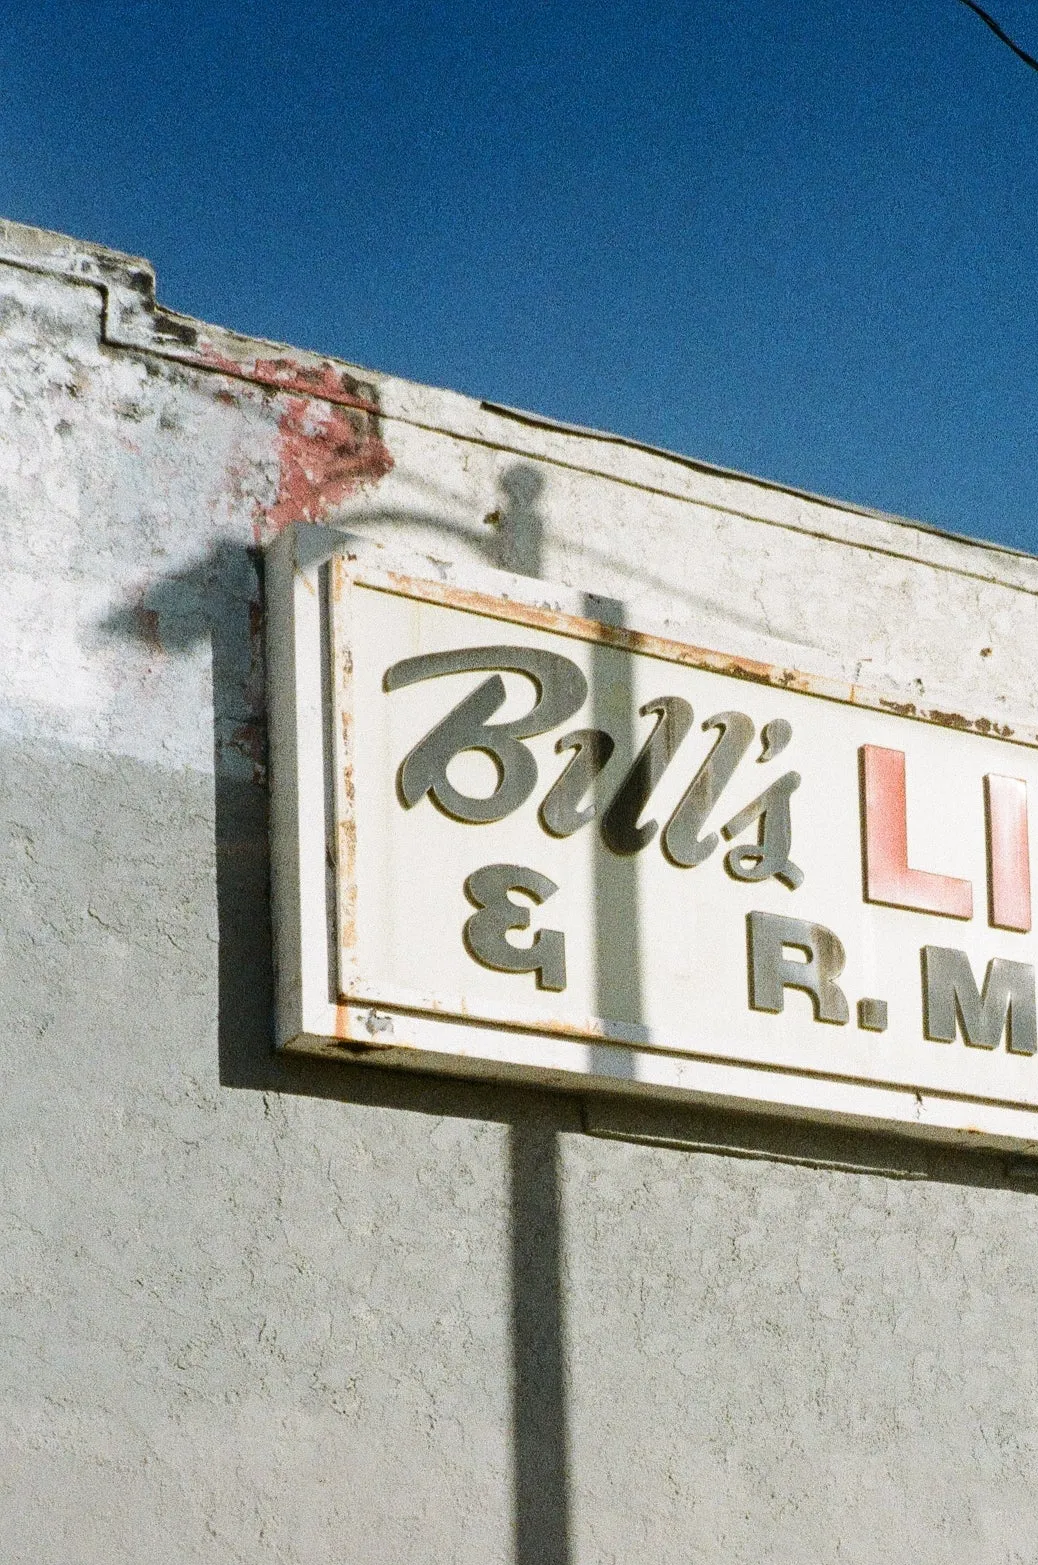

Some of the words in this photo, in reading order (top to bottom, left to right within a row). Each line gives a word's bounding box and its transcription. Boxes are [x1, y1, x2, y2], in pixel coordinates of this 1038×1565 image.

[383, 645, 805, 891] Bill's
[462, 863, 566, 992] &
[746, 910, 888, 1032] R.
